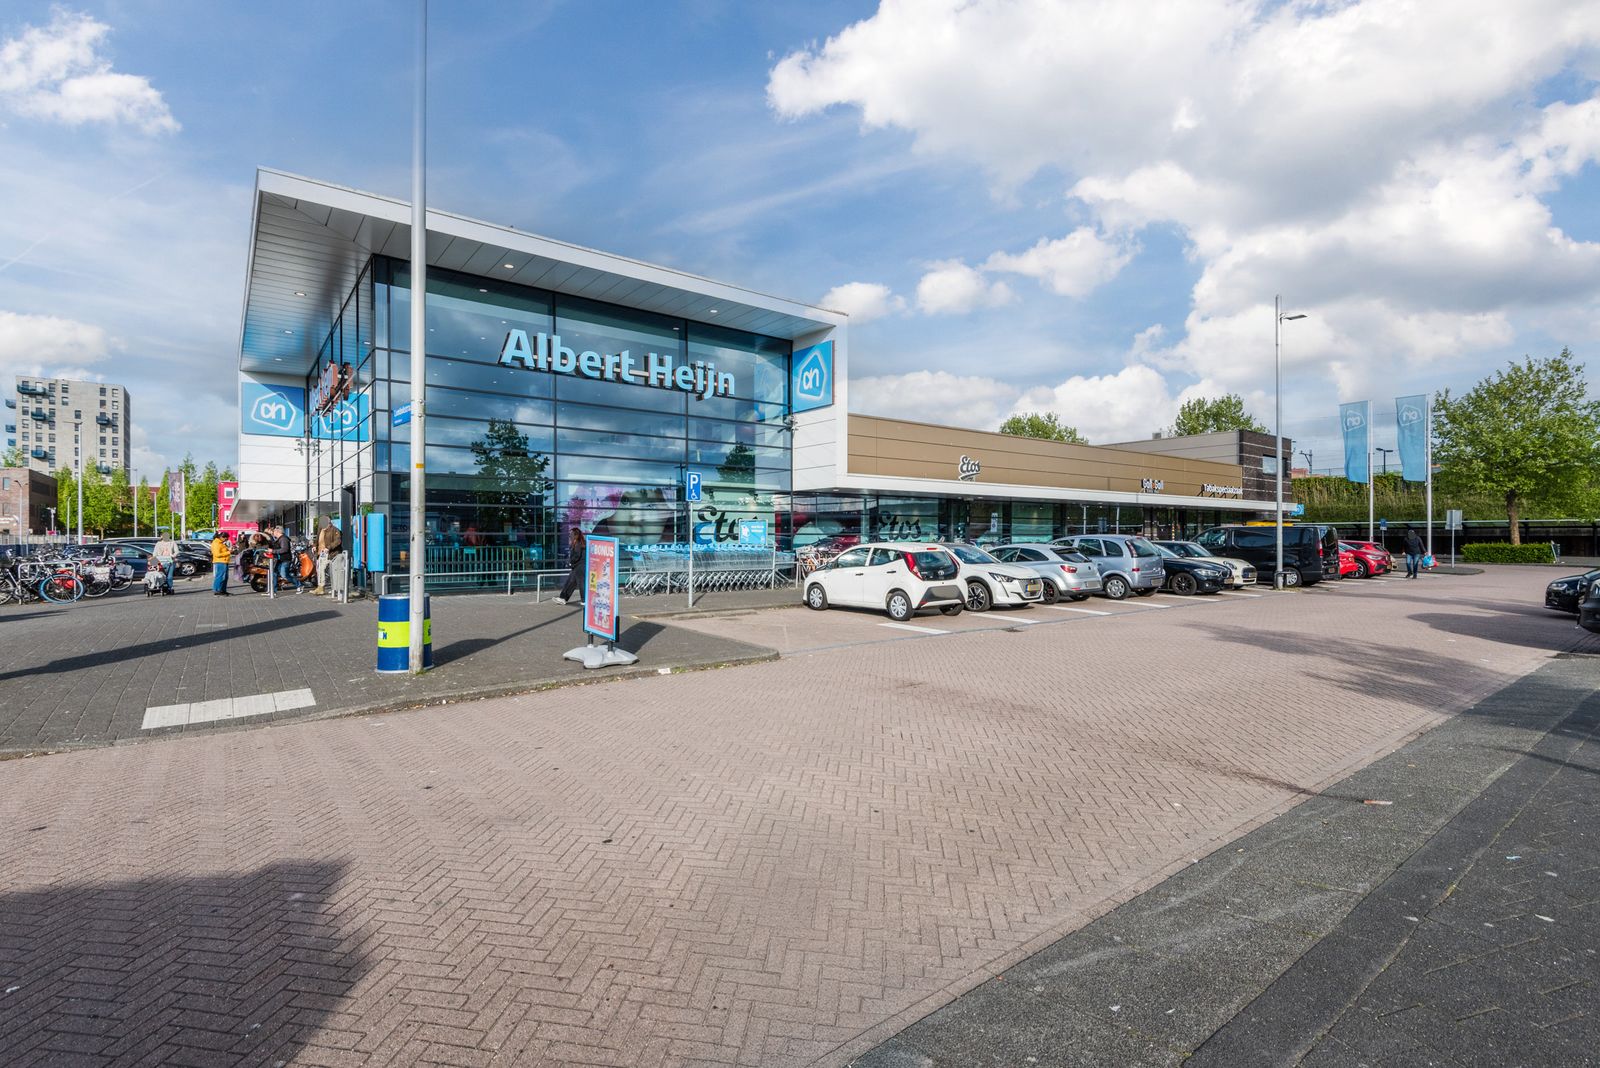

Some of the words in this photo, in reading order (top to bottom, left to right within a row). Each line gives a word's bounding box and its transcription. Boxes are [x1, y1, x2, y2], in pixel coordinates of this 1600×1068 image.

[499, 329, 634, 383] Albert
[648, 352, 735, 399] Heijn
[959, 455, 981, 474] Etos
[691, 475, 698, 489] P
[595, 545, 613, 557] BONUS
